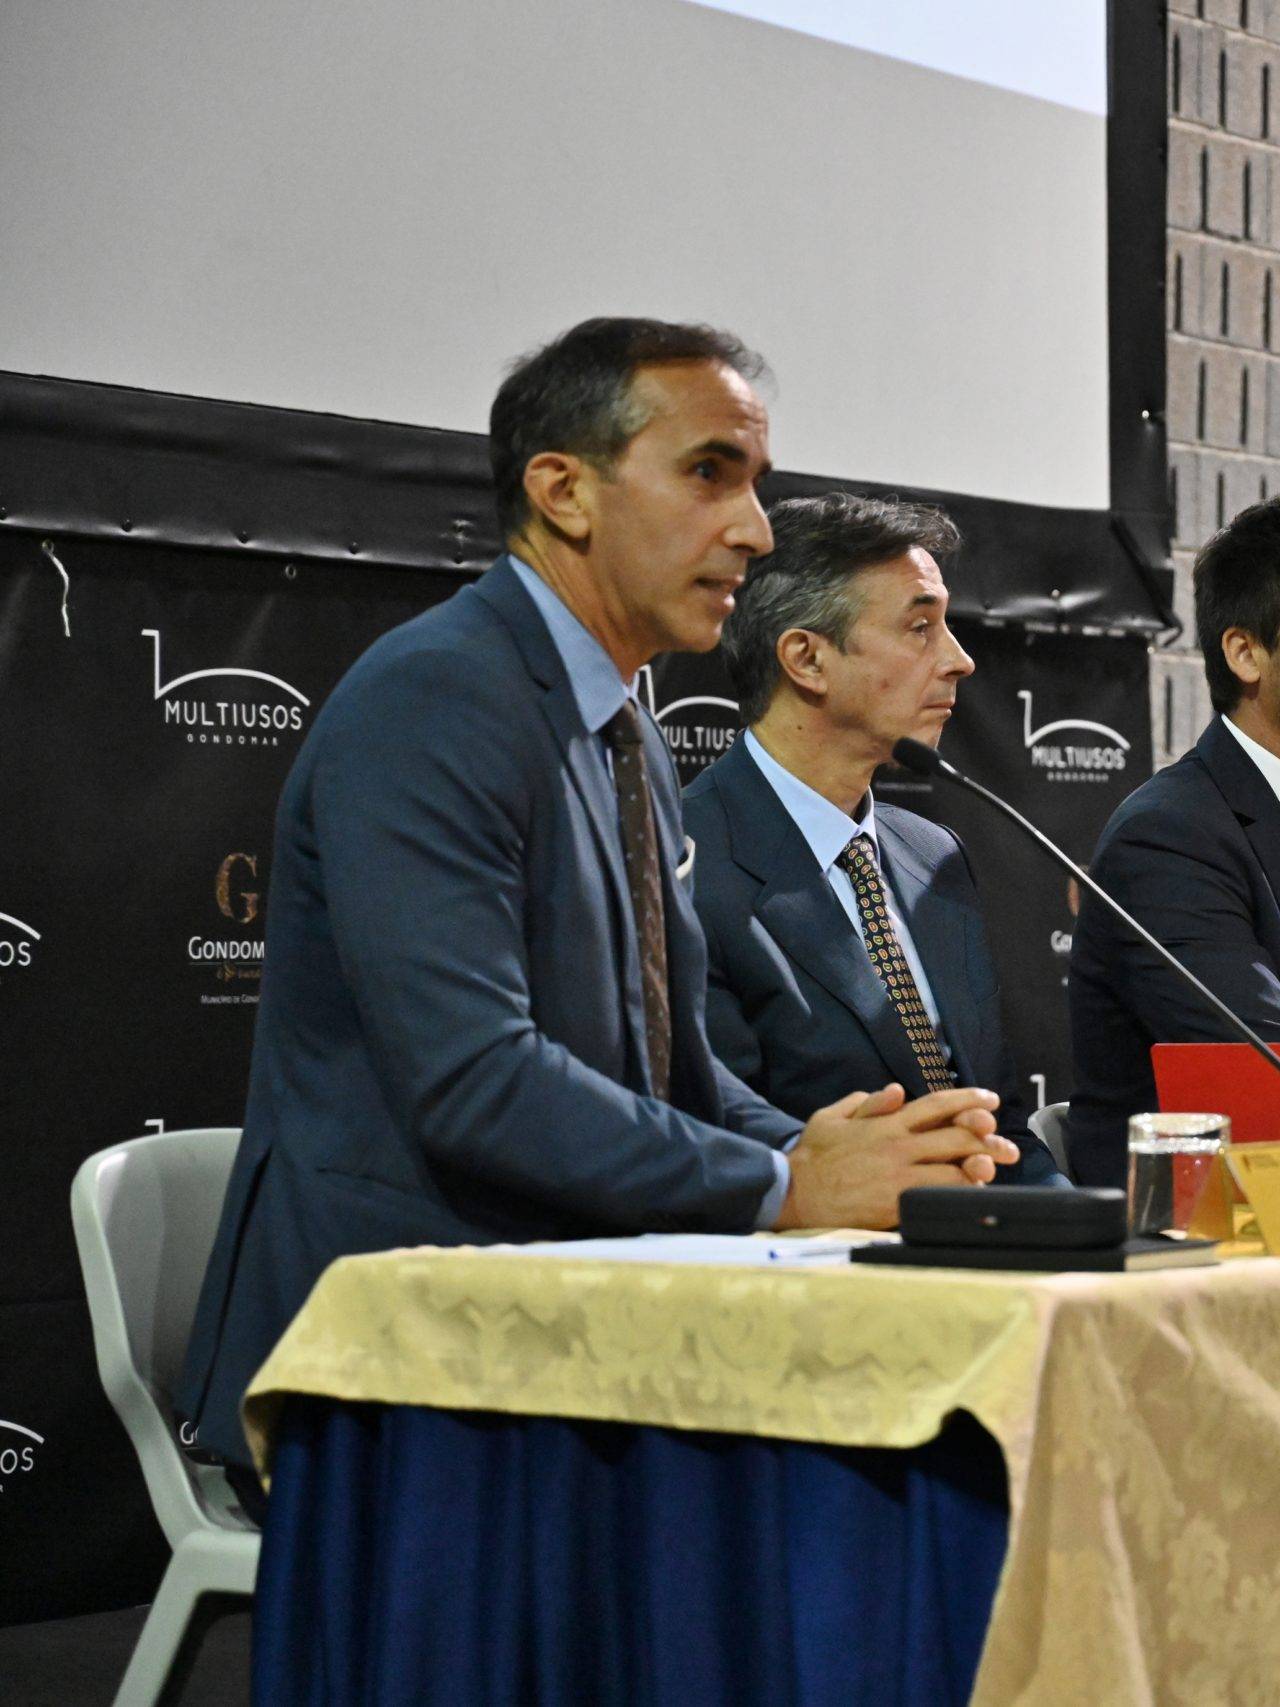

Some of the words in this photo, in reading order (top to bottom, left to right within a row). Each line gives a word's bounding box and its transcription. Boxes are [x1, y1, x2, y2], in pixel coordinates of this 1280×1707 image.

[165, 699, 302, 731] MULTIUSOS
[187, 733, 278, 746] GONDOMAR
[661, 725, 745, 751] ULTIUS
[1031, 745, 1126, 770] MULTIUSOS
[188, 936, 265, 960] GONDOM
